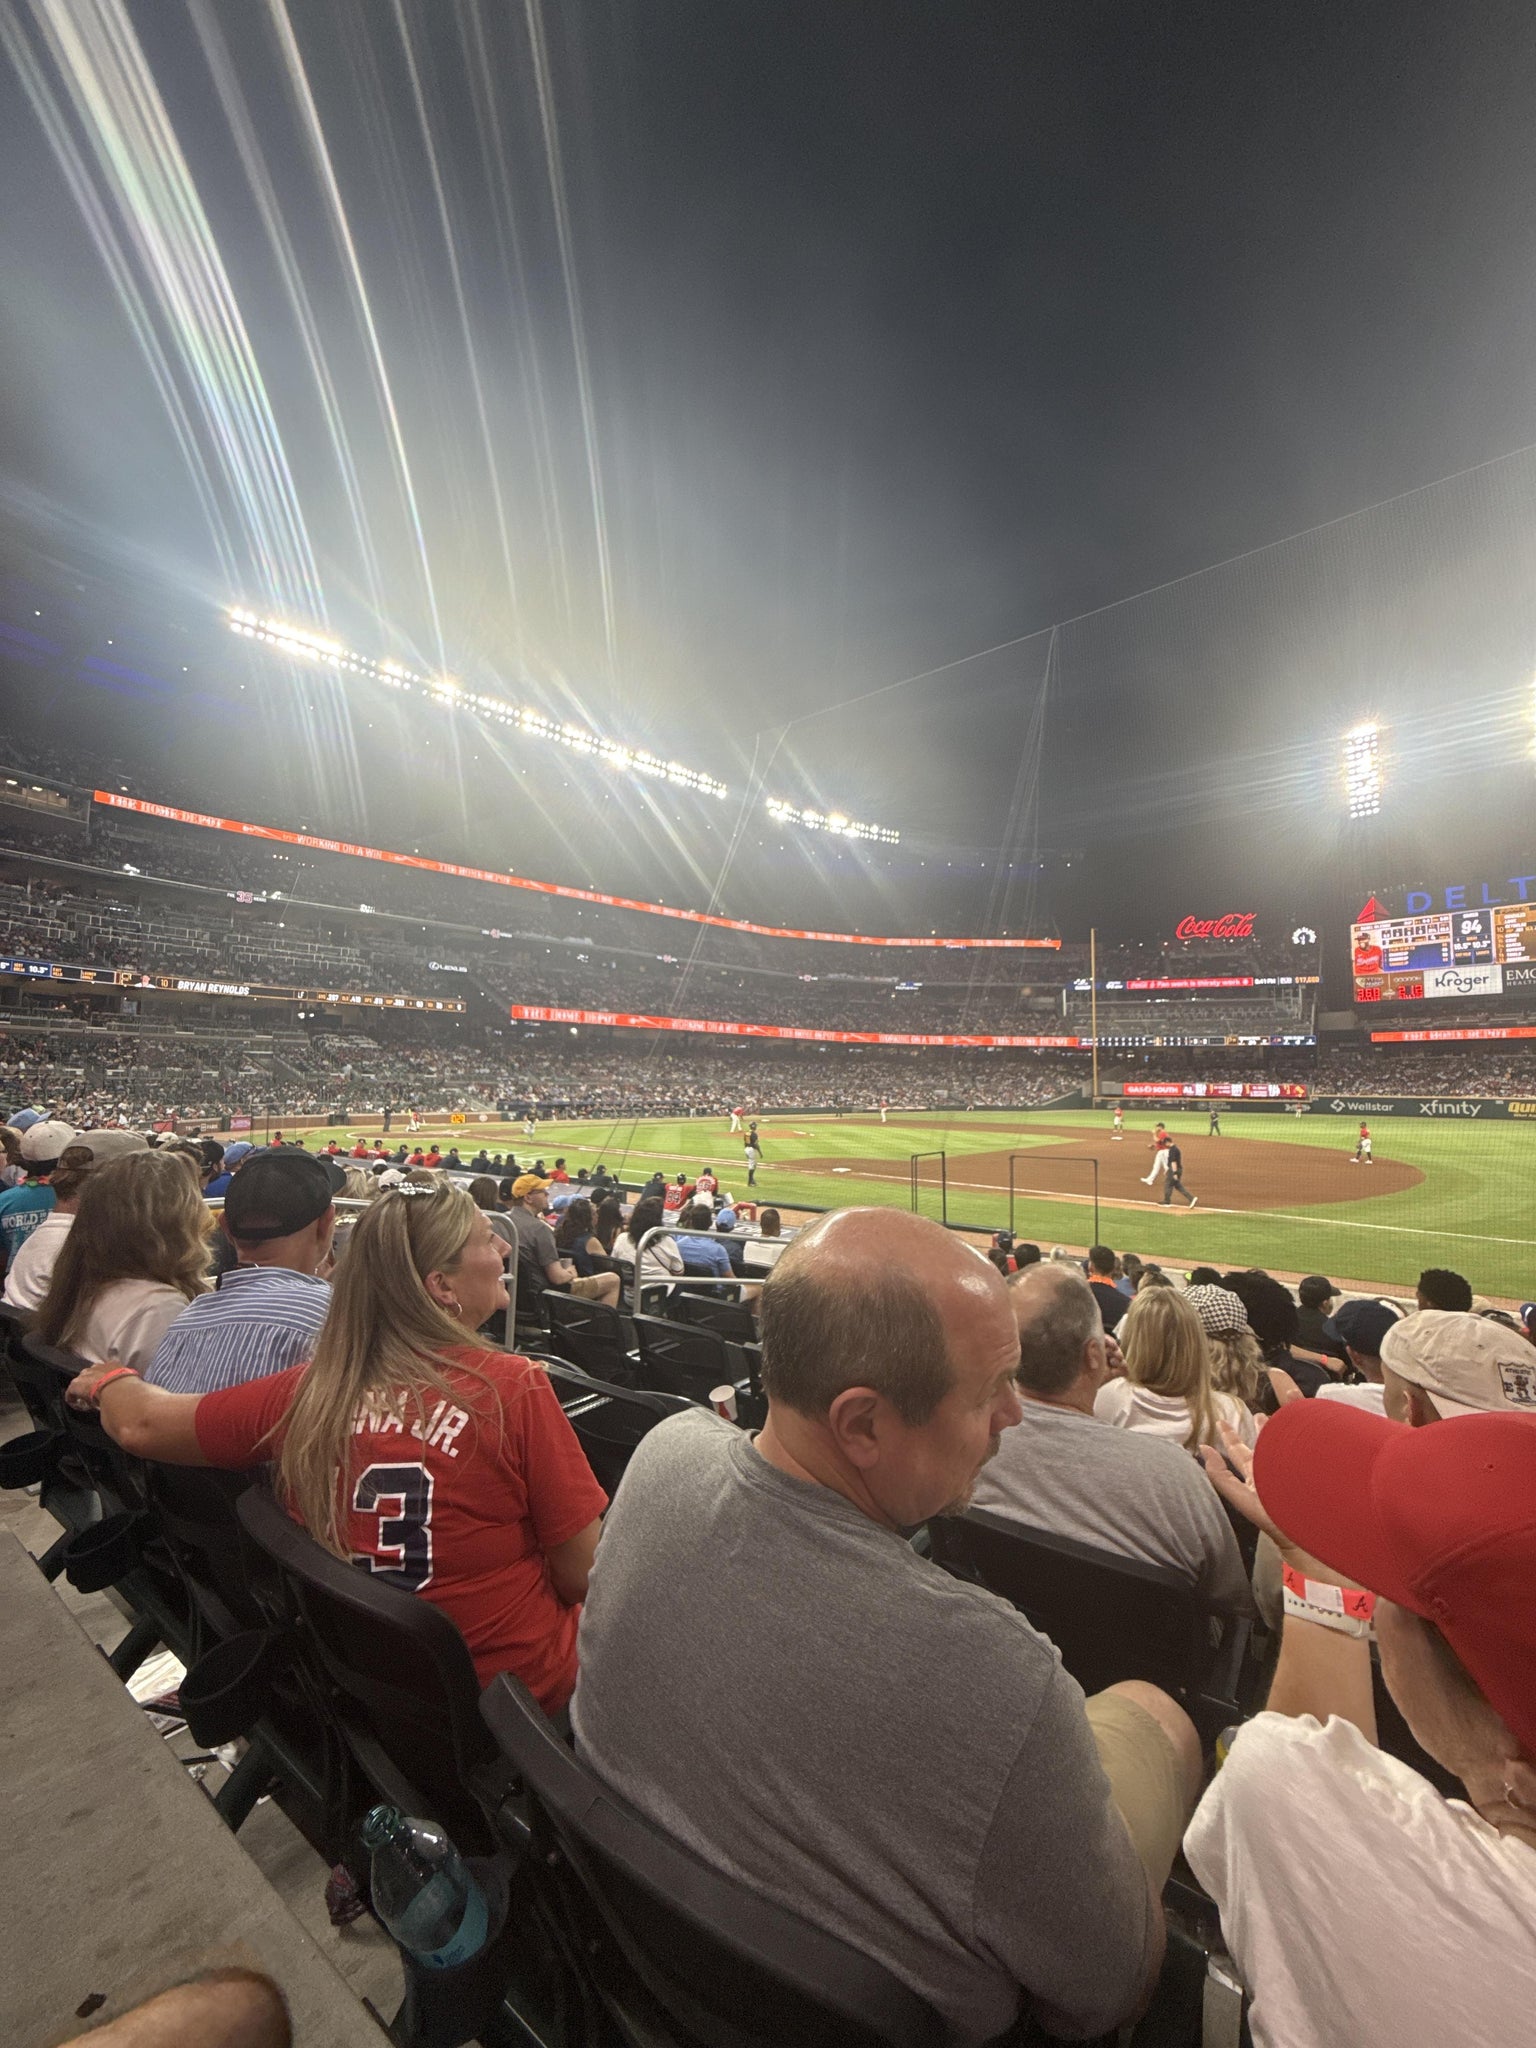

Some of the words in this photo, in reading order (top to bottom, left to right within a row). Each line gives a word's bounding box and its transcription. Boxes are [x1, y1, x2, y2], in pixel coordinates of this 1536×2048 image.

[108, 794, 137, 809] THE
[141, 801, 178, 819] HOME
[182, 810, 222, 829] DEPOT
[297, 835, 340, 852] WORKING
[343, 844, 355, 855] ON
[356, 846, 364, 856] A
[365, 847, 382, 859] WIN
[1175, 913, 1257, 939] Coca-Cola
[1461, 920, 1482, 934] 94
[160, 979, 169, 987] 10
[177, 980, 207, 991] BRYAN
[207, 983, 250, 995] REYNOLDS
[1435, 971, 1490, 993] Kroger
[522, 1006, 546, 1020] THE
[550, 1008, 580, 1022] HOME
[1347, 1102, 1394, 1112] Wellstar
[1419, 1100, 1482, 1117] xfinity
[1, 1213, 39, 1229] WORLD
[410, 1400, 470, 1458] JR.
[353, 1462, 435, 1592] 3
[1353, 1595, 1368, 1612] A
